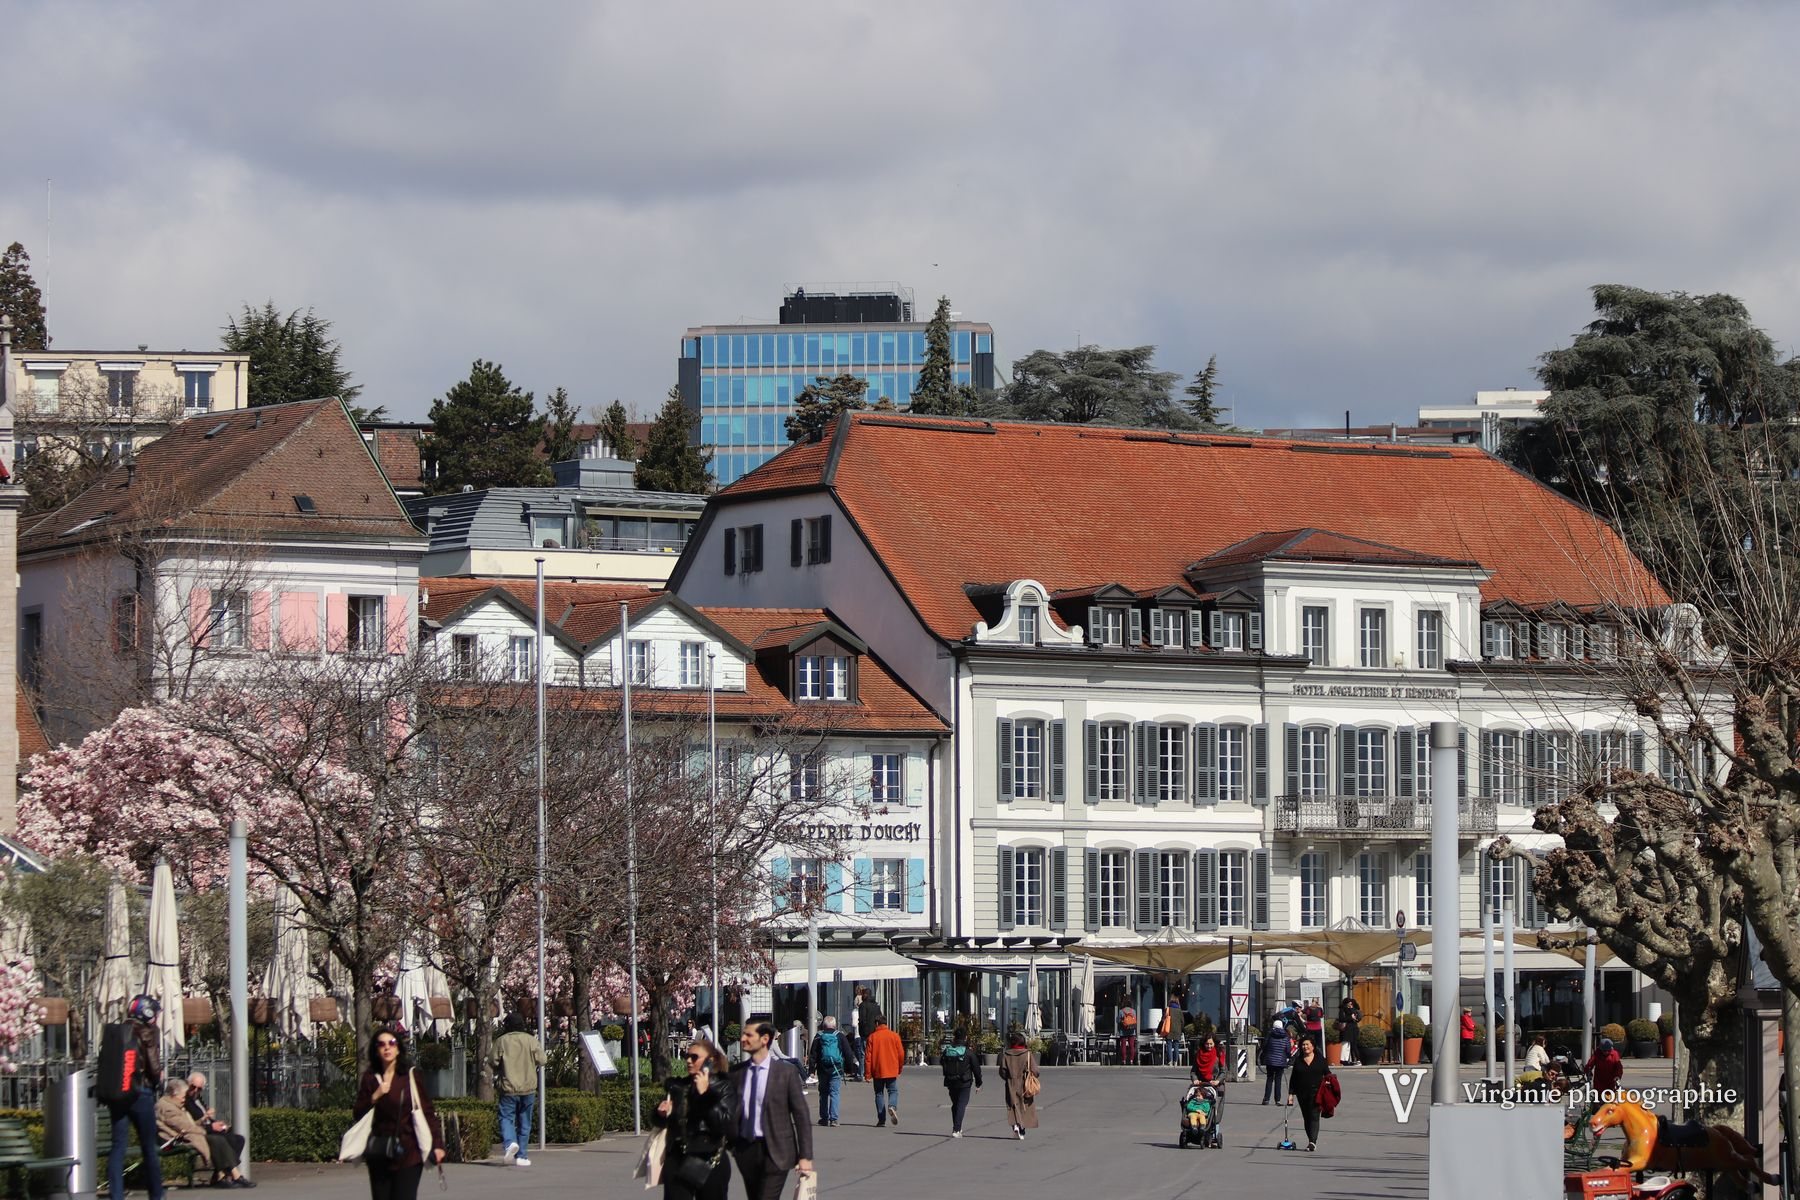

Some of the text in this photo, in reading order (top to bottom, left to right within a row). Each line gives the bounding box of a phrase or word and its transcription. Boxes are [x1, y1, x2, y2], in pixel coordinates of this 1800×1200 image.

[1329, 685, 1389, 697] ANGLETERRE
[1391, 687, 1405, 698] ET
[860, 822, 921, 843] D'OUCHY
